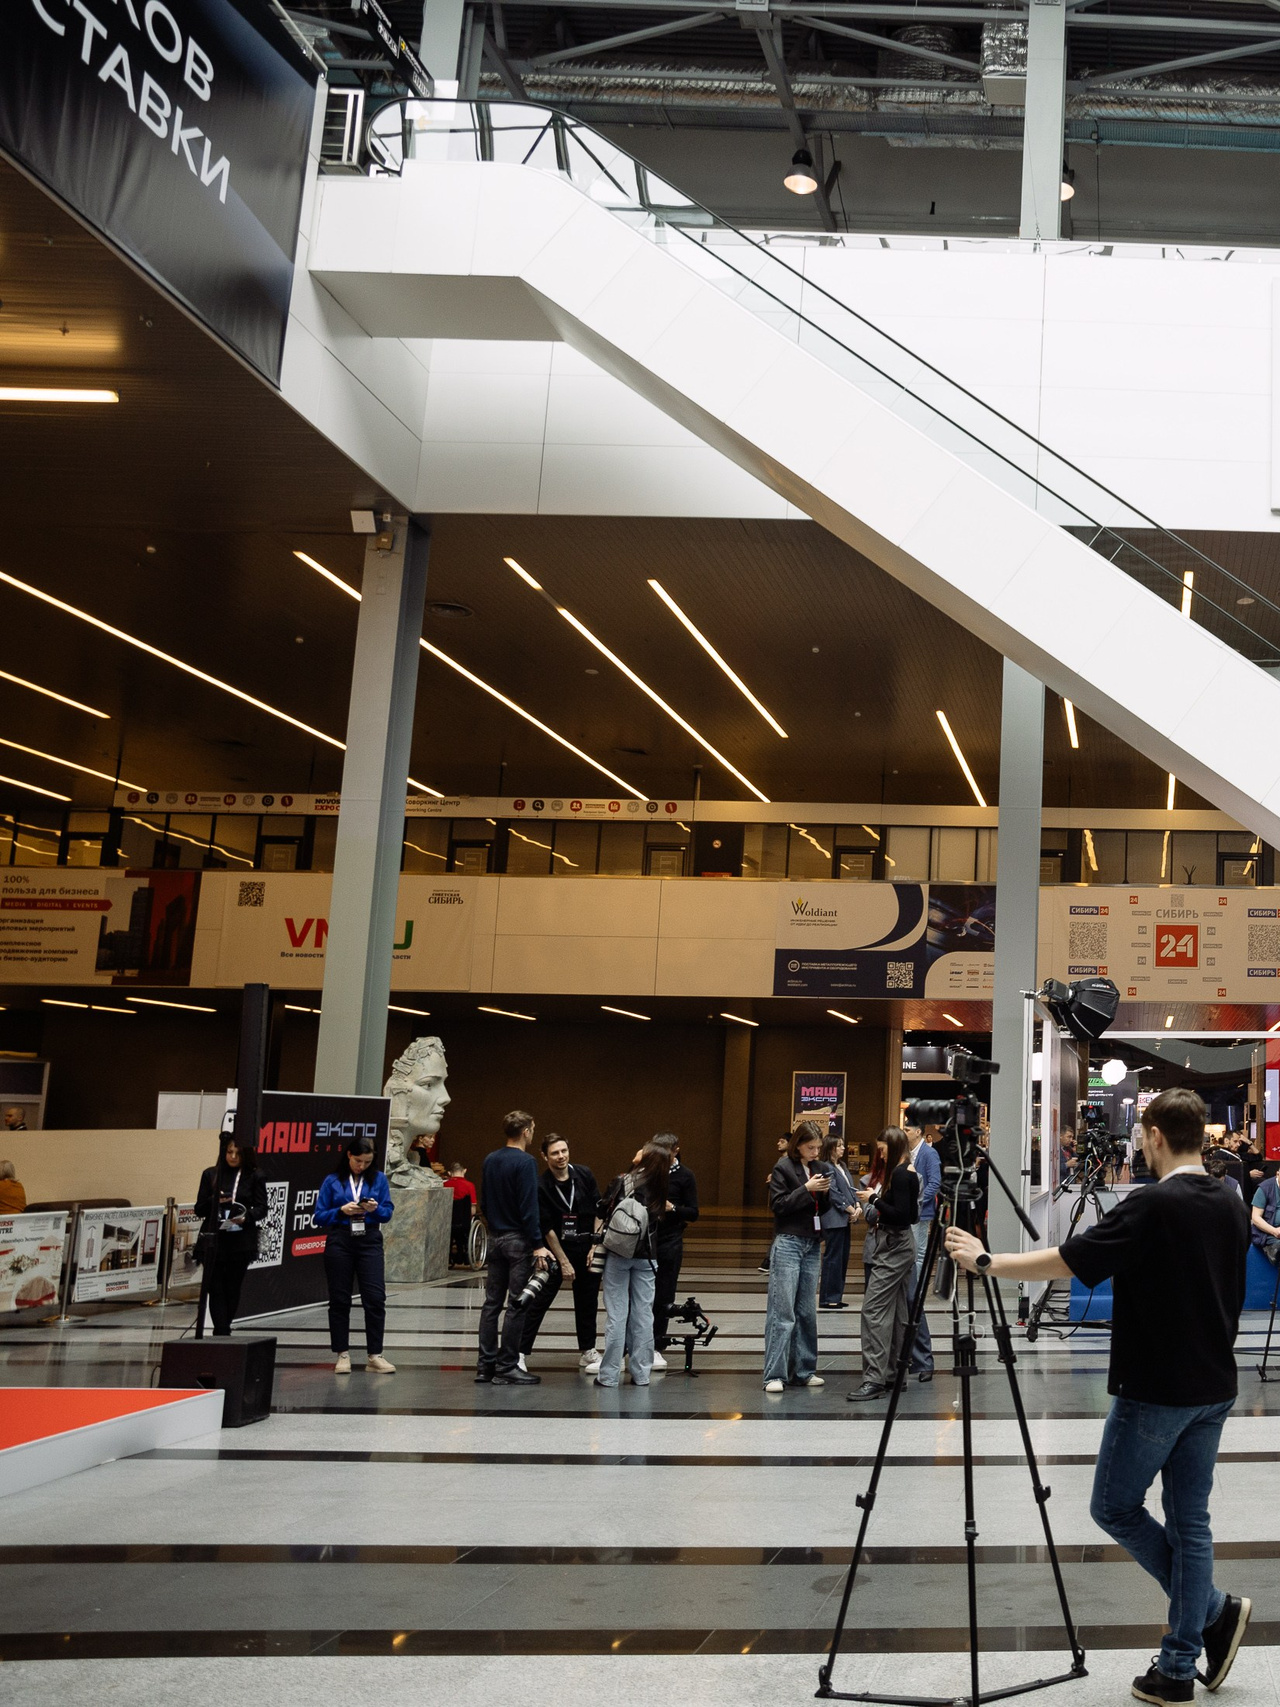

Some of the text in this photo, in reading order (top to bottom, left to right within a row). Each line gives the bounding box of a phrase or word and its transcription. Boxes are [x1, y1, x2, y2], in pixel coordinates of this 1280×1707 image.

[3, 875, 30, 884] 100%
[1, 886, 99, 896] польза для бизнеса
[427, 896, 464, 905] СИБИРЬ
[791, 900, 838, 917] Woldiant
[1156, 908, 1199, 919] СИБИРЬ
[1160, 934, 1194, 958] 24
[801, 1086, 838, 1097] МАШ
[257, 1121, 377, 1153] МАШ ЭКСПО
[314, 1144, 342, 1152] СИБ
